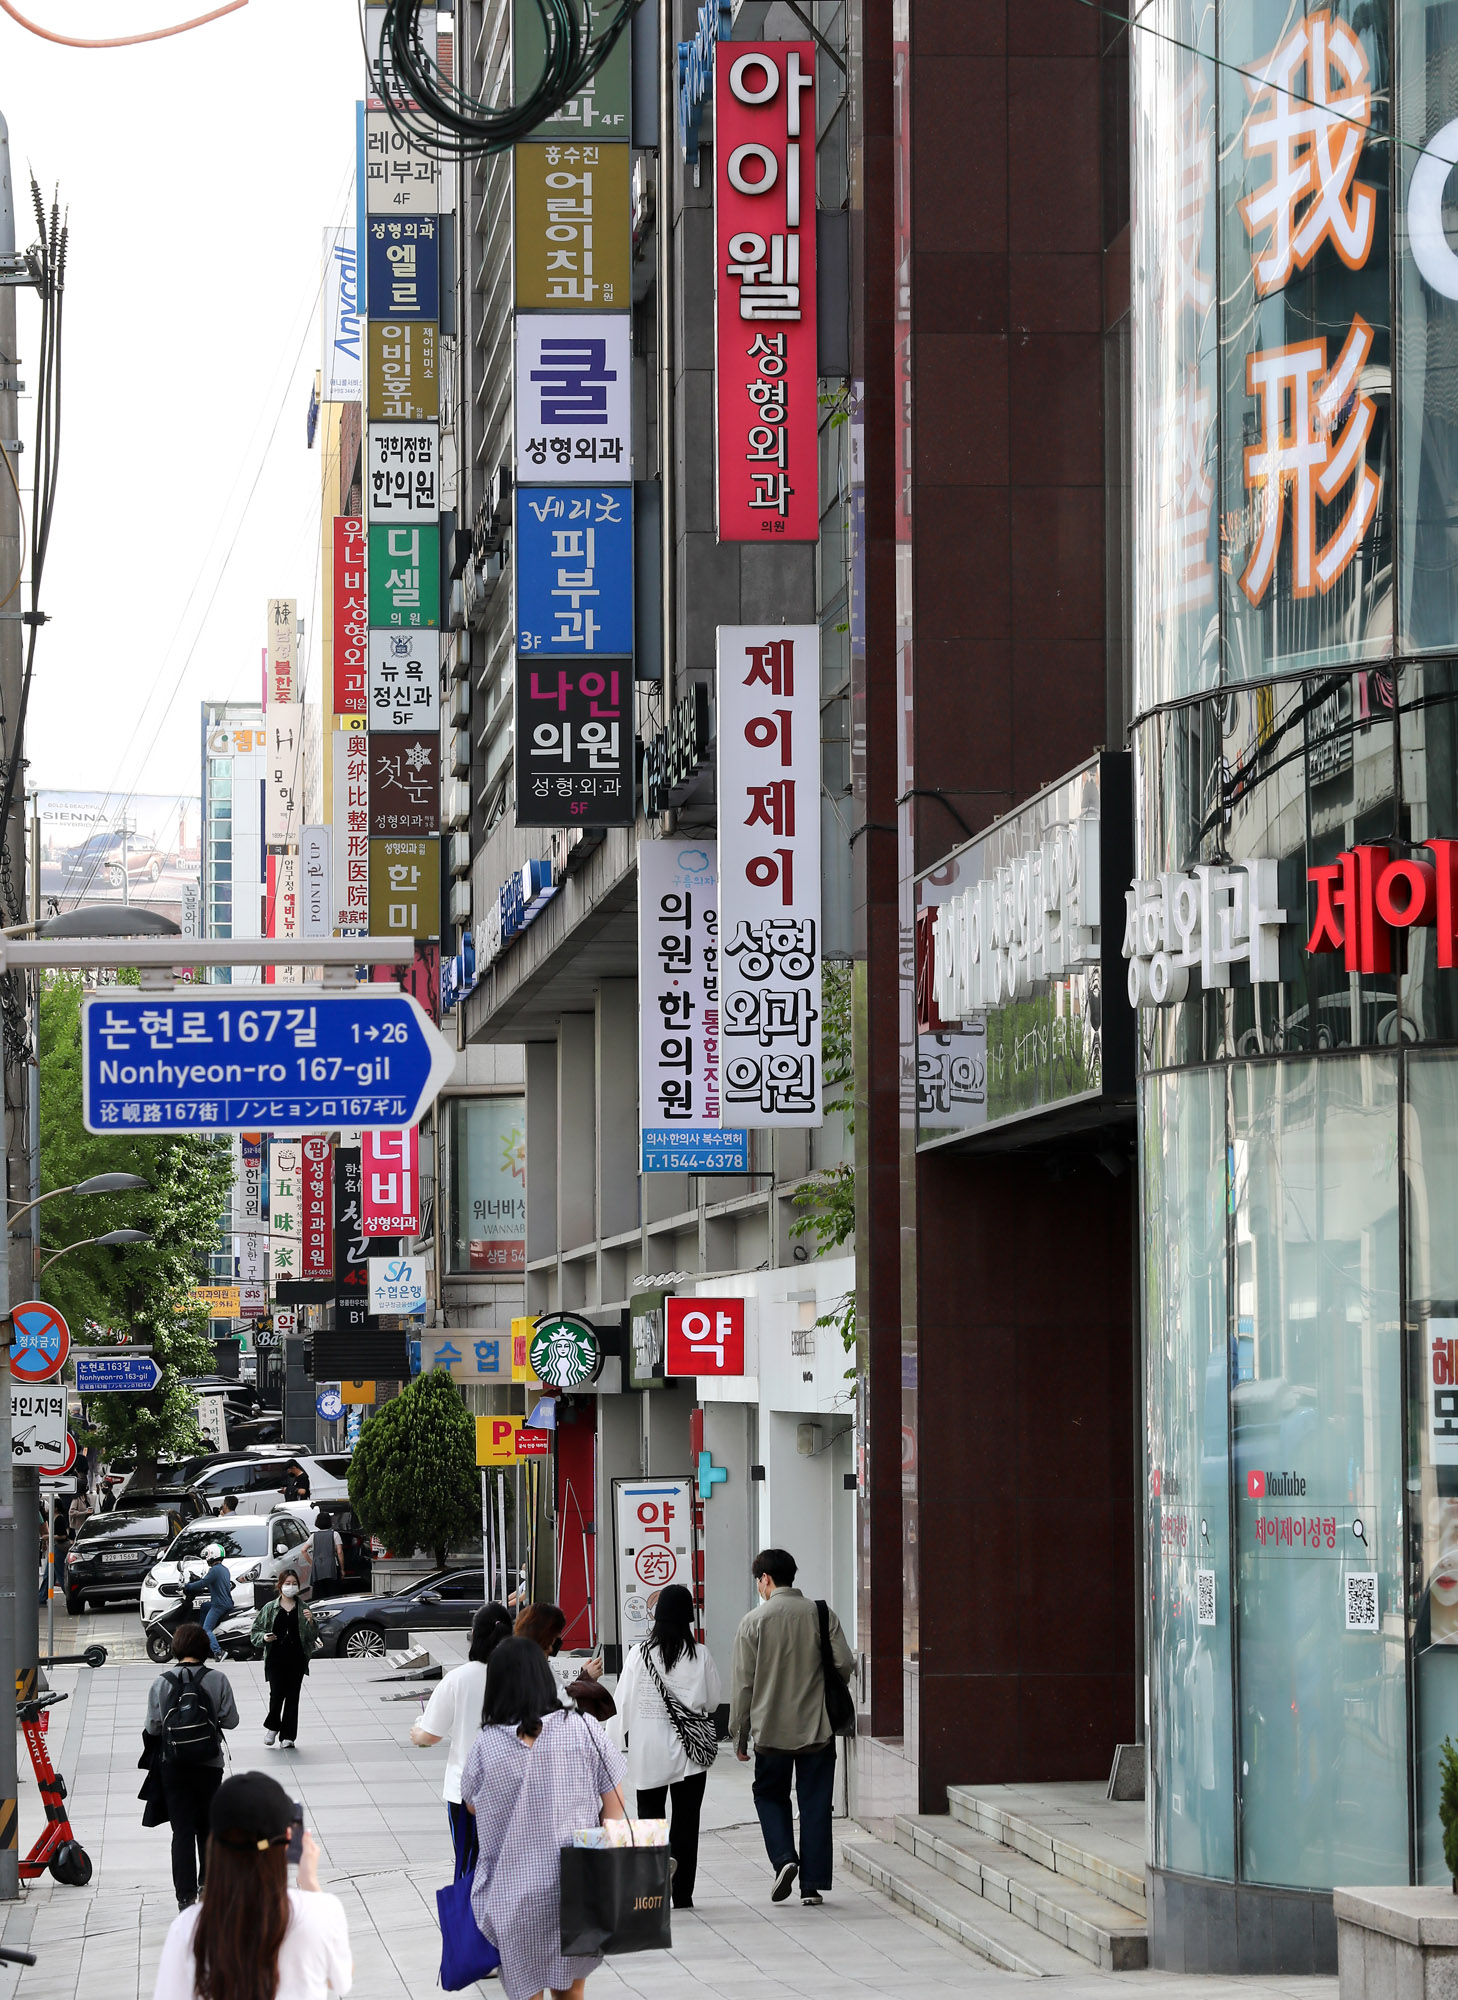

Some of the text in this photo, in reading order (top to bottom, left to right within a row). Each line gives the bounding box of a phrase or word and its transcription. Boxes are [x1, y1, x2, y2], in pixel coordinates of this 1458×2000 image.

[601, 114, 625, 125] 4F
[545, 146, 599, 165] 홍수진
[368, 160, 437, 184] 피부과
[726, 51, 813, 321] 아이웰
[392, 192, 411, 205] 4F
[371, 223, 435, 240] 성형외과
[545, 172, 599, 303] 어린이치과
[386, 244, 421, 311] 엘르
[602, 282, 614, 302] 의원
[381, 325, 415, 419] 이비인후과
[530, 339, 617, 425] 쿨
[746, 333, 793, 516] 성형외과
[524, 437, 624, 464] 성형외과
[371, 470, 435, 510] 한의원
[760, 519, 786, 533] 의원
[384, 529, 421, 607] 디셀
[551, 527, 601, 650] 피부과
[390, 612, 421, 626] 의원
[520, 631, 542, 650] 3F
[380, 660, 424, 683] 뉴욕
[373, 686, 433, 708] 정신과
[530, 670, 621, 718] 나인
[392, 711, 414, 725] 5F
[530, 722, 620, 769] 의원
[375, 755, 434, 804] 첫눈
[742, 639, 797, 906] 제이제이
[43, 811, 109, 823] SIENNA
[375, 814, 423, 829] 성형외과
[570, 802, 588, 814] 5F
[311, 842, 321, 860] UP
[284, 860, 294, 891] 압구정
[311, 884, 321, 922] POINT
[388, 864, 422, 930] 한미
[1121, 858, 1287, 1008] 성형외과
[724, 918, 816, 981] 성형
[99, 1007, 318, 1050] 논현로167길
[724, 988, 818, 1047] 외과
[99, 1057, 391, 1089] Nonhyeon-ro 167-gil
[724, 1053, 816, 1114] 의원
[702, 1132, 743, 1147] 복수면허
[646, 1154, 743, 1169] T.1544-6378
[245, 1168, 260, 1216] 한의원
[309, 1161, 326, 1267] 성형외과의원
[365, 1216, 418, 1232] 성형외과
[487, 1249, 508, 1264] 상담
[384, 1261, 413, 1283] Sh
[374, 1284, 422, 1299] 수협은행
[350, 1311, 365, 1324] B1
[681, 1311, 732, 1368] 약
[80, 1361, 131, 1373] 논현로163길
[434, 1339, 500, 1373] 수협
[125, 1373, 148, 1381] 163-gil
[493, 1421, 512, 1445] P
[1266, 1471, 1306, 1497] YouTube
[637, 1501, 675, 1543] 약
[1254, 1516, 1338, 1549] 제이제이성형
[28, 1729, 43, 1765] DART
[633, 1895, 663, 1910] JIGOTT
